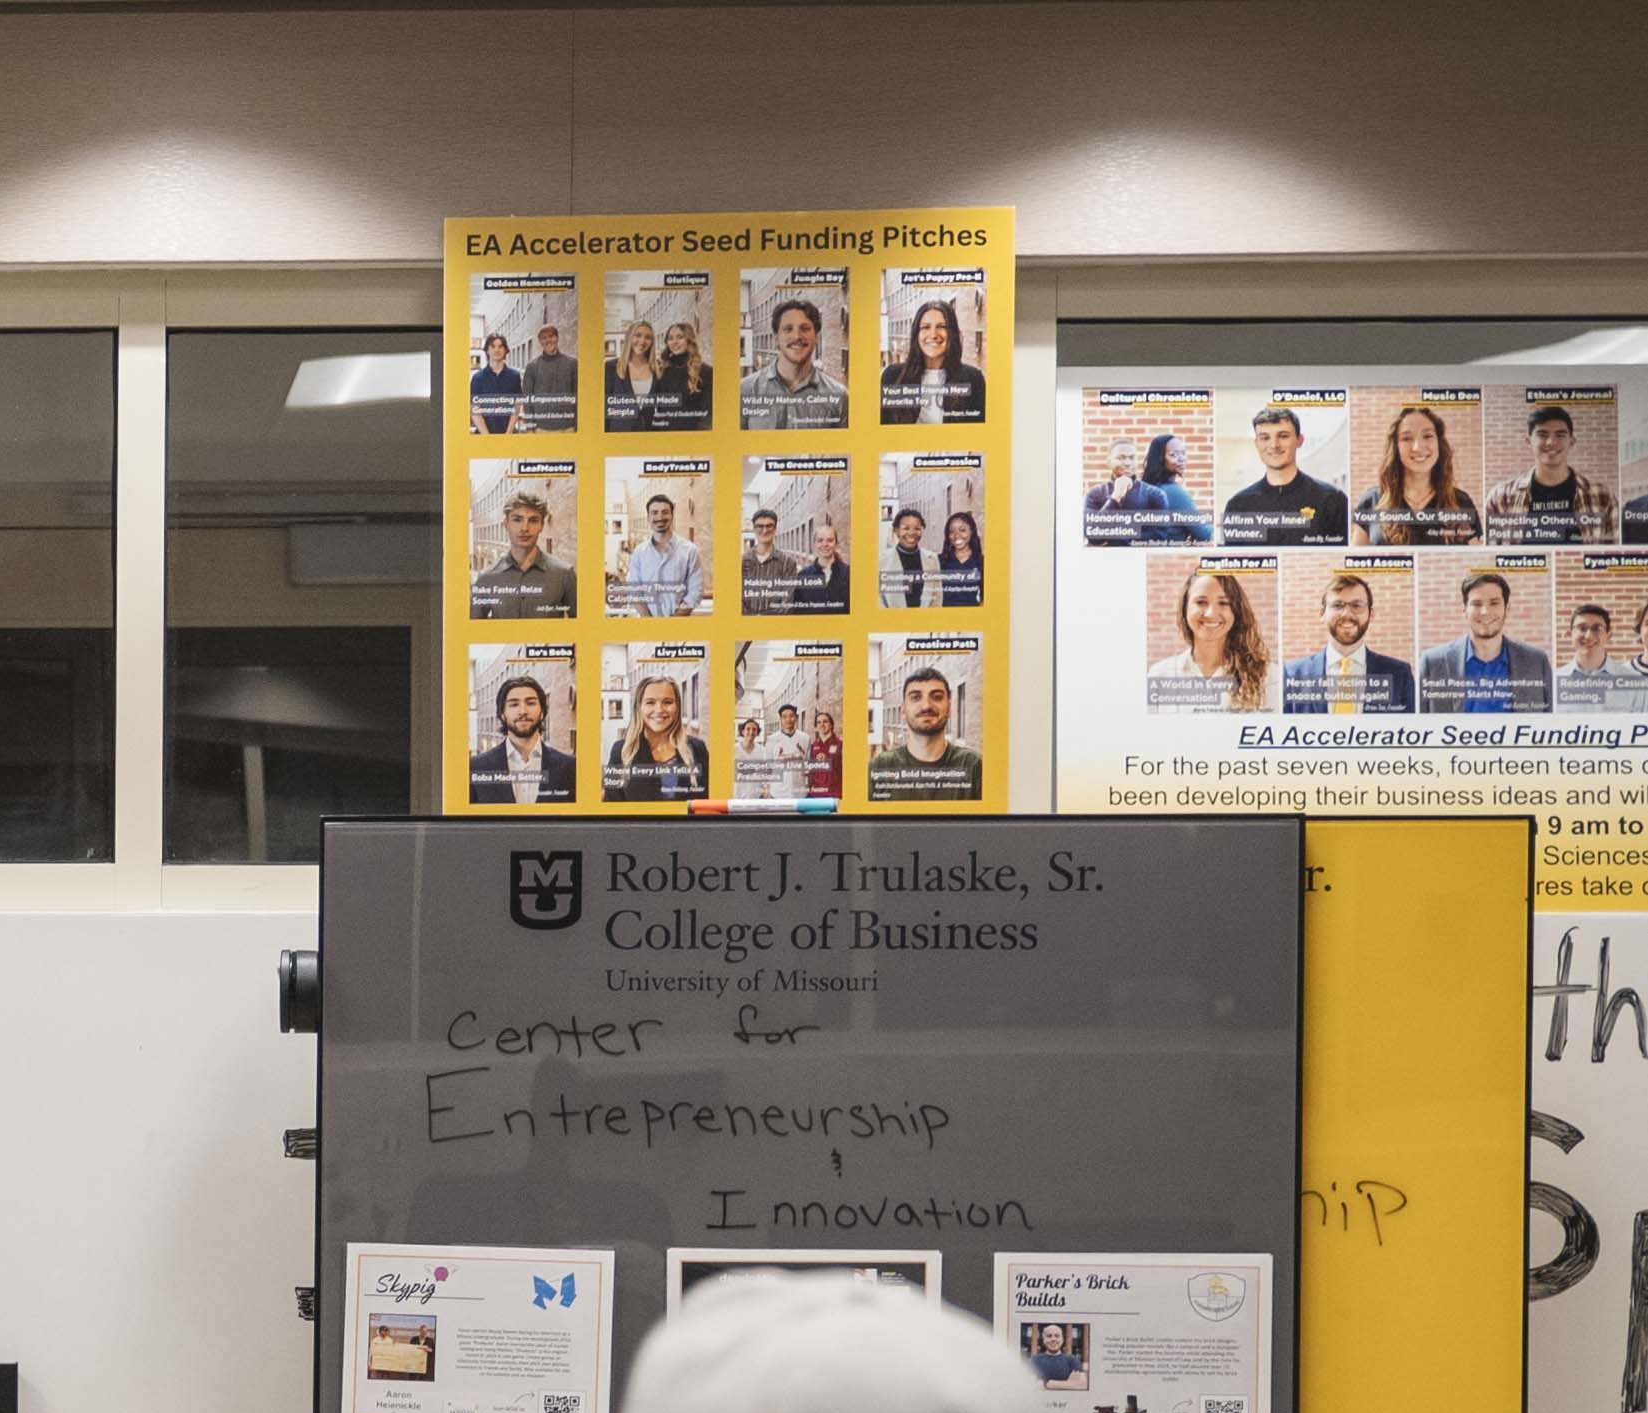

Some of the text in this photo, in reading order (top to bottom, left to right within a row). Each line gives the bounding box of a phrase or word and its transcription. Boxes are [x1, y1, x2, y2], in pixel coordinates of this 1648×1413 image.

[466, 224, 988, 257] EA Accelerator Seed Funding Pitches
[1086, 513, 1212, 524] Honoring Culture Through
[1224, 515, 1306, 525] Affirm Your Inner
[1353, 511, 1471, 523] Your Sound. Our Space.
[1086, 526, 1137, 536] Education.
[1224, 528, 1263, 538] Winner.
[1560, 692, 1601, 702] Gaming.
[1239, 725, 1275, 746] EA
[1282, 724, 1432, 746] Accelerator
[1441, 724, 1505, 746] Seed
[1513, 724, 1621, 749] Funding
[1125, 755, 1634, 780] For the past seven weeks, fourteen teams
[1109, 785, 1167, 807] been
[1176, 785, 1306, 810] developing
[1316, 785, 1368, 806] their
[1376, 785, 1483, 806] business
[1492, 784, 1557, 806] ideas
[1566, 783, 1610, 806] and
[1548, 816, 1643, 835] 9 am to
[606, 851, 1104, 900] Robert J. Trulaske, Sr.
[1582, 876, 1632, 896] take
[605, 908, 1038, 963] College of Business
[605, 969, 879, 1000] University of Missouri
[446, 1003, 822, 1057] Center for
[427, 1067, 951, 1150] Entrepreneurship
[707, 1188, 1033, 1232] Innovation
[376, 1273, 437, 1305] Skypig
[1015, 1272, 1130, 1291] Parker's Brick
[1015, 1291, 1066, 1308] Builds
[385, 1390, 413, 1400] Aaron
